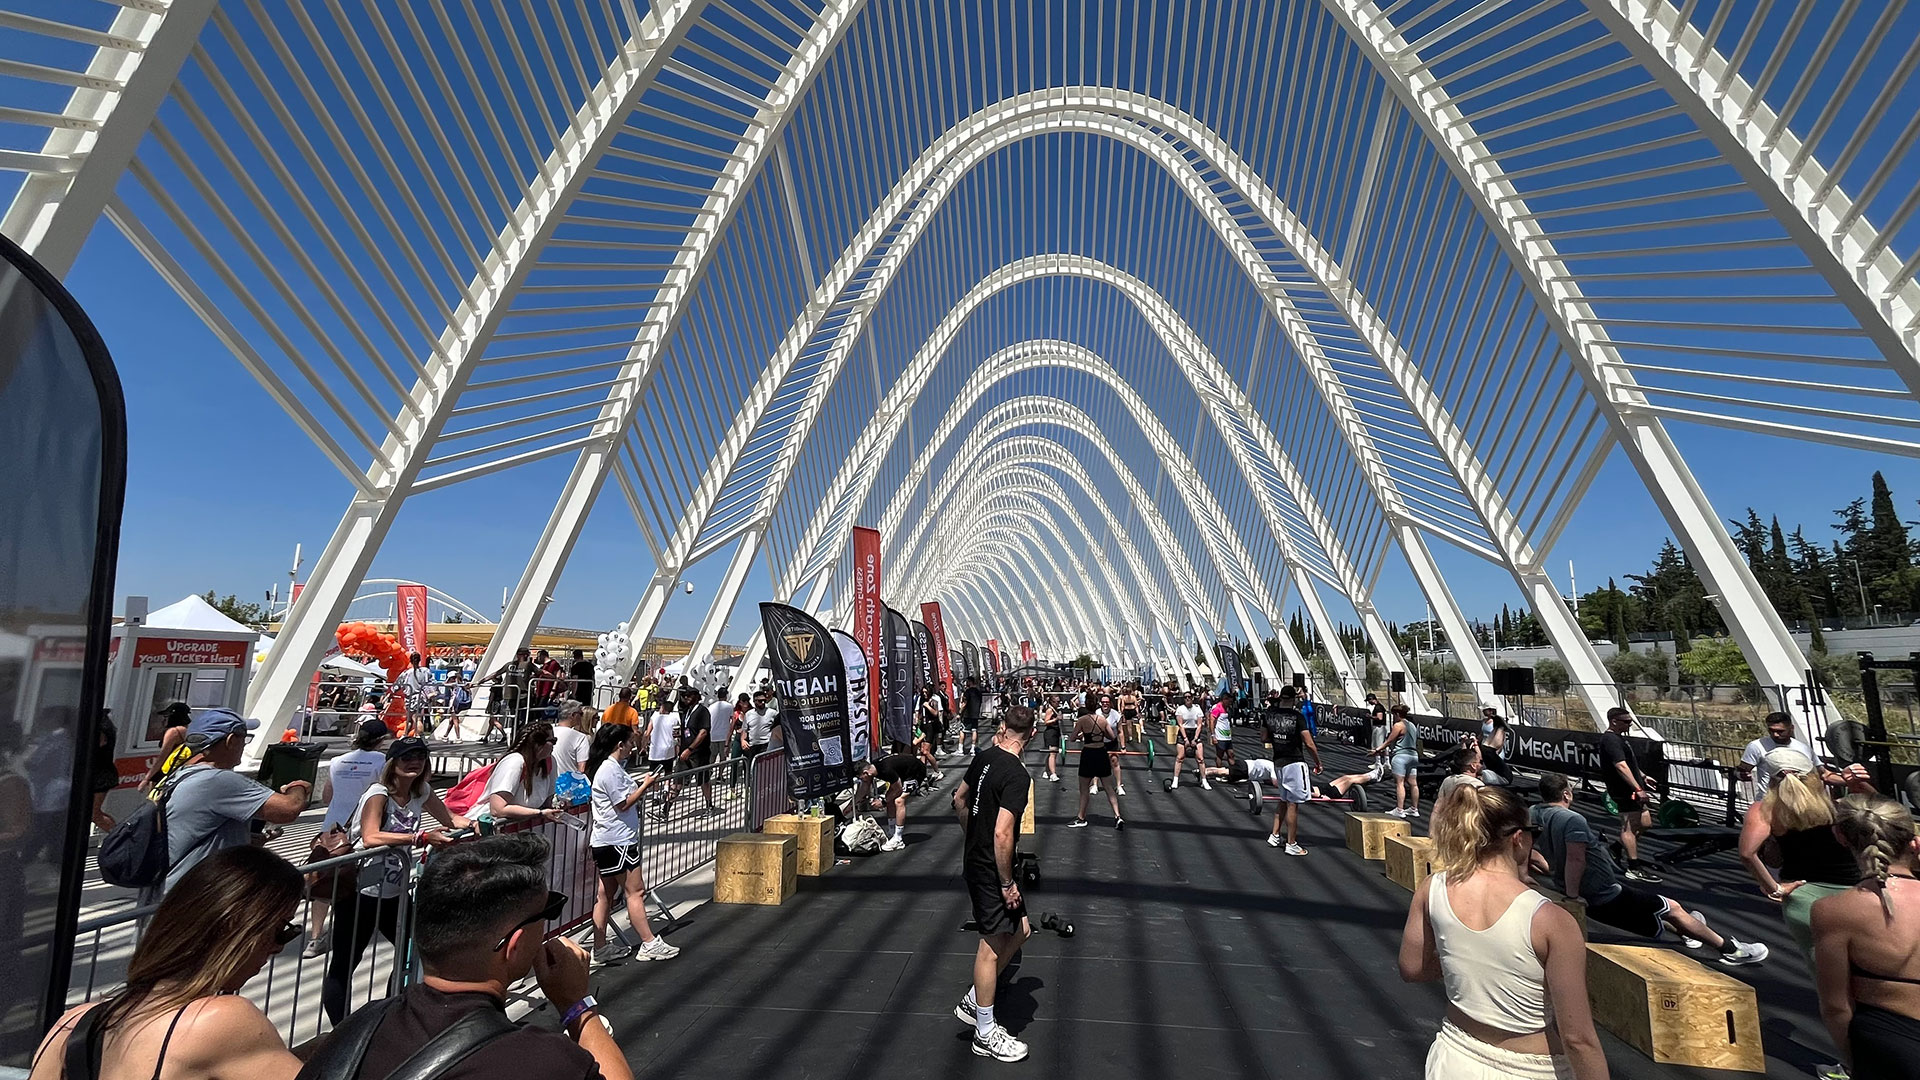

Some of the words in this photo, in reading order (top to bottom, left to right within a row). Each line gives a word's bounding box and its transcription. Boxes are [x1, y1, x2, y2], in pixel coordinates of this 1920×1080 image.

[166, 640, 219, 652] UPGRADE
[139, 654, 167, 663] YOUR
[171, 652, 208, 663] TICKET
[210, 654, 240, 663] HERE!
[848, 664, 868, 759] PHYSICA
[1664, 999, 1676, 1008] 40
